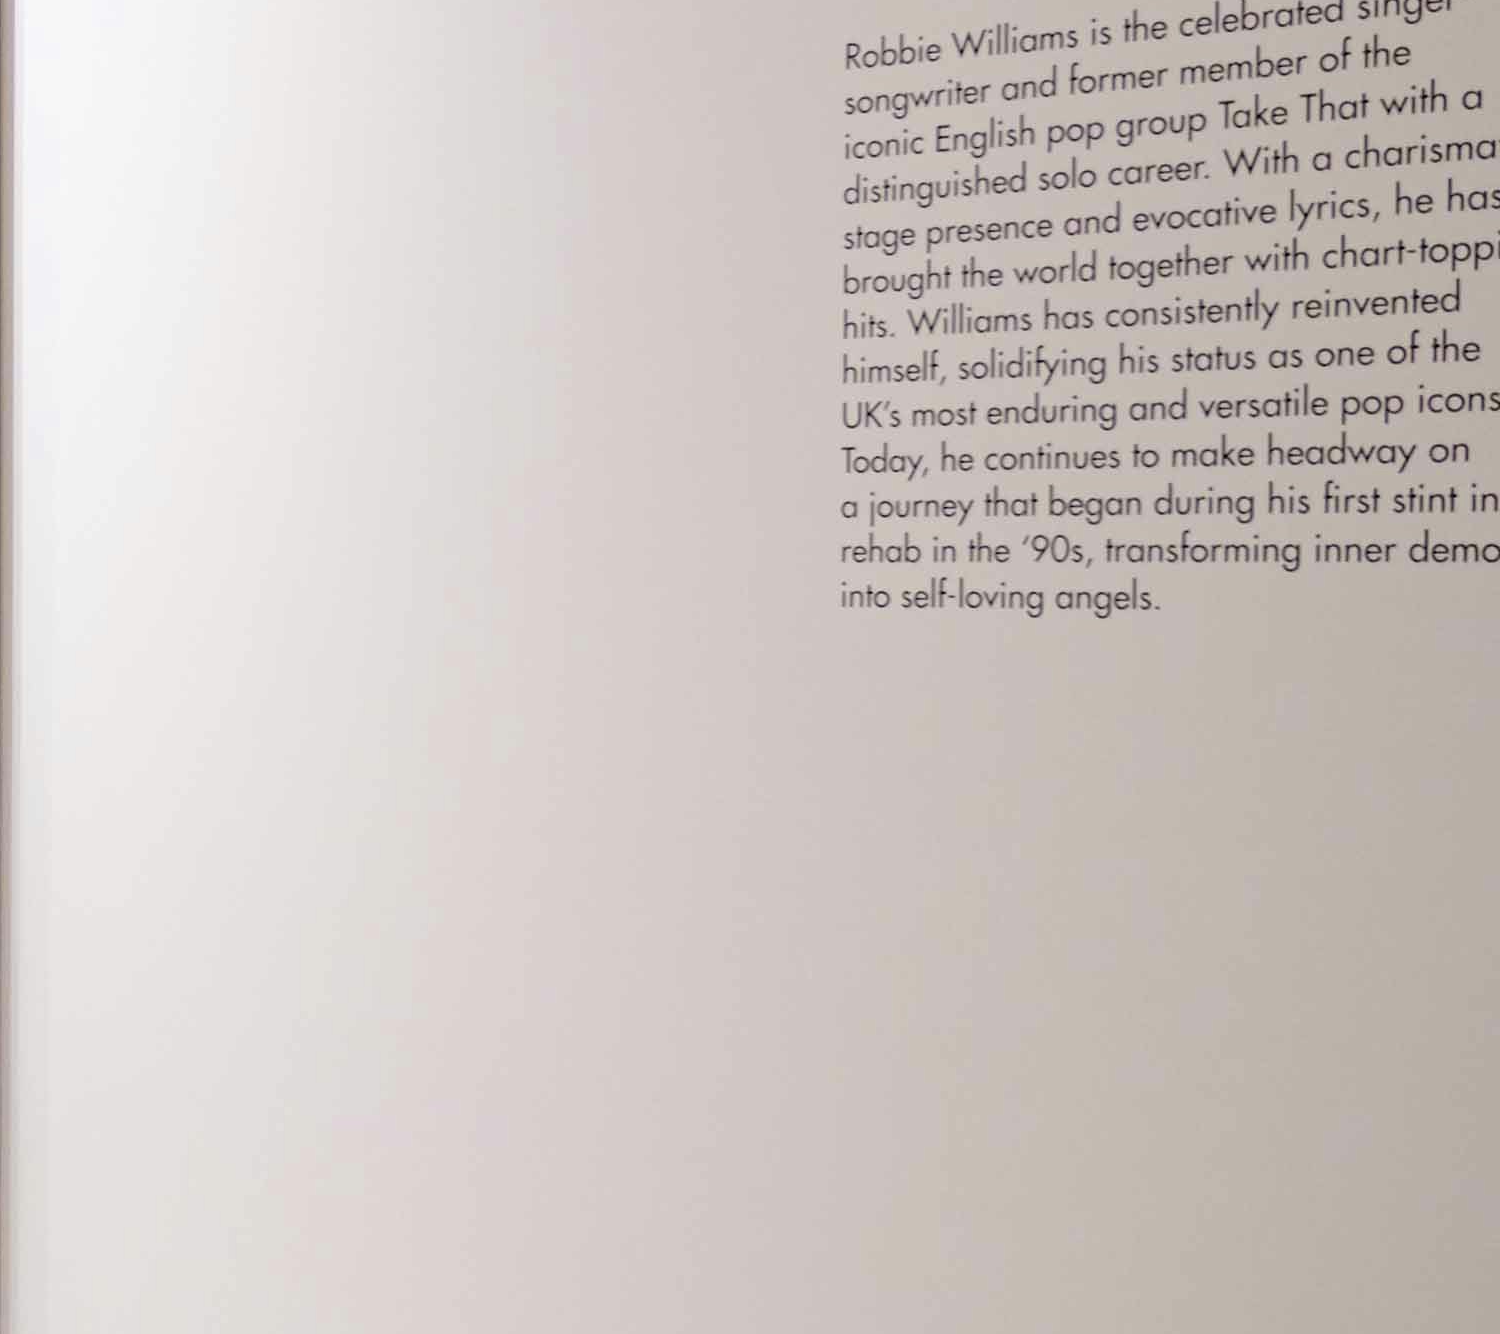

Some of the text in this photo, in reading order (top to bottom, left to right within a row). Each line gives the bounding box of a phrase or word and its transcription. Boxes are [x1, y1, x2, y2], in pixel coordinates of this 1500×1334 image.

[846, 33, 942, 69] Robbie
[951, 22, 1079, 57] Williams
[1091, 18, 1113, 46] is
[1123, 9, 1169, 43] the
[844, 33, 1412, 120] songwriter and former member of the
[845, 78, 1483, 160] iconic English pop group Take That with a
[843, 160, 1027, 209] distinguished
[1038, 156, 1097, 192] solo
[1107, 160, 1210, 187] career.
[1223, 140, 1299, 177] With
[1311, 151, 1332, 172] a
[844, 177, 1500, 257] stage presence and evocative lyrics, he has
[843, 259, 952, 300] brought
[961, 256, 1004, 288] the
[1013, 249, 1097, 284] world
[1108, 243, 1235, 289] together
[1243, 236, 1310, 272] with
[843, 277, 1462, 339] hits. Williams has consistently reinvented
[843, 327, 1482, 386] himself, solidifying his status as one of the
[843, 382, 1500, 432] UK's most enduring and versatile pop icons
[840, 430, 1471, 481] Today, he continues to make headway on
[841, 479, 1499, 527] a journey that began during his first stint in
[841, 528, 1500, 573] rehab in the '90s, transforming inner demo
[841, 576, 1161, 620] into self-loving angels.
